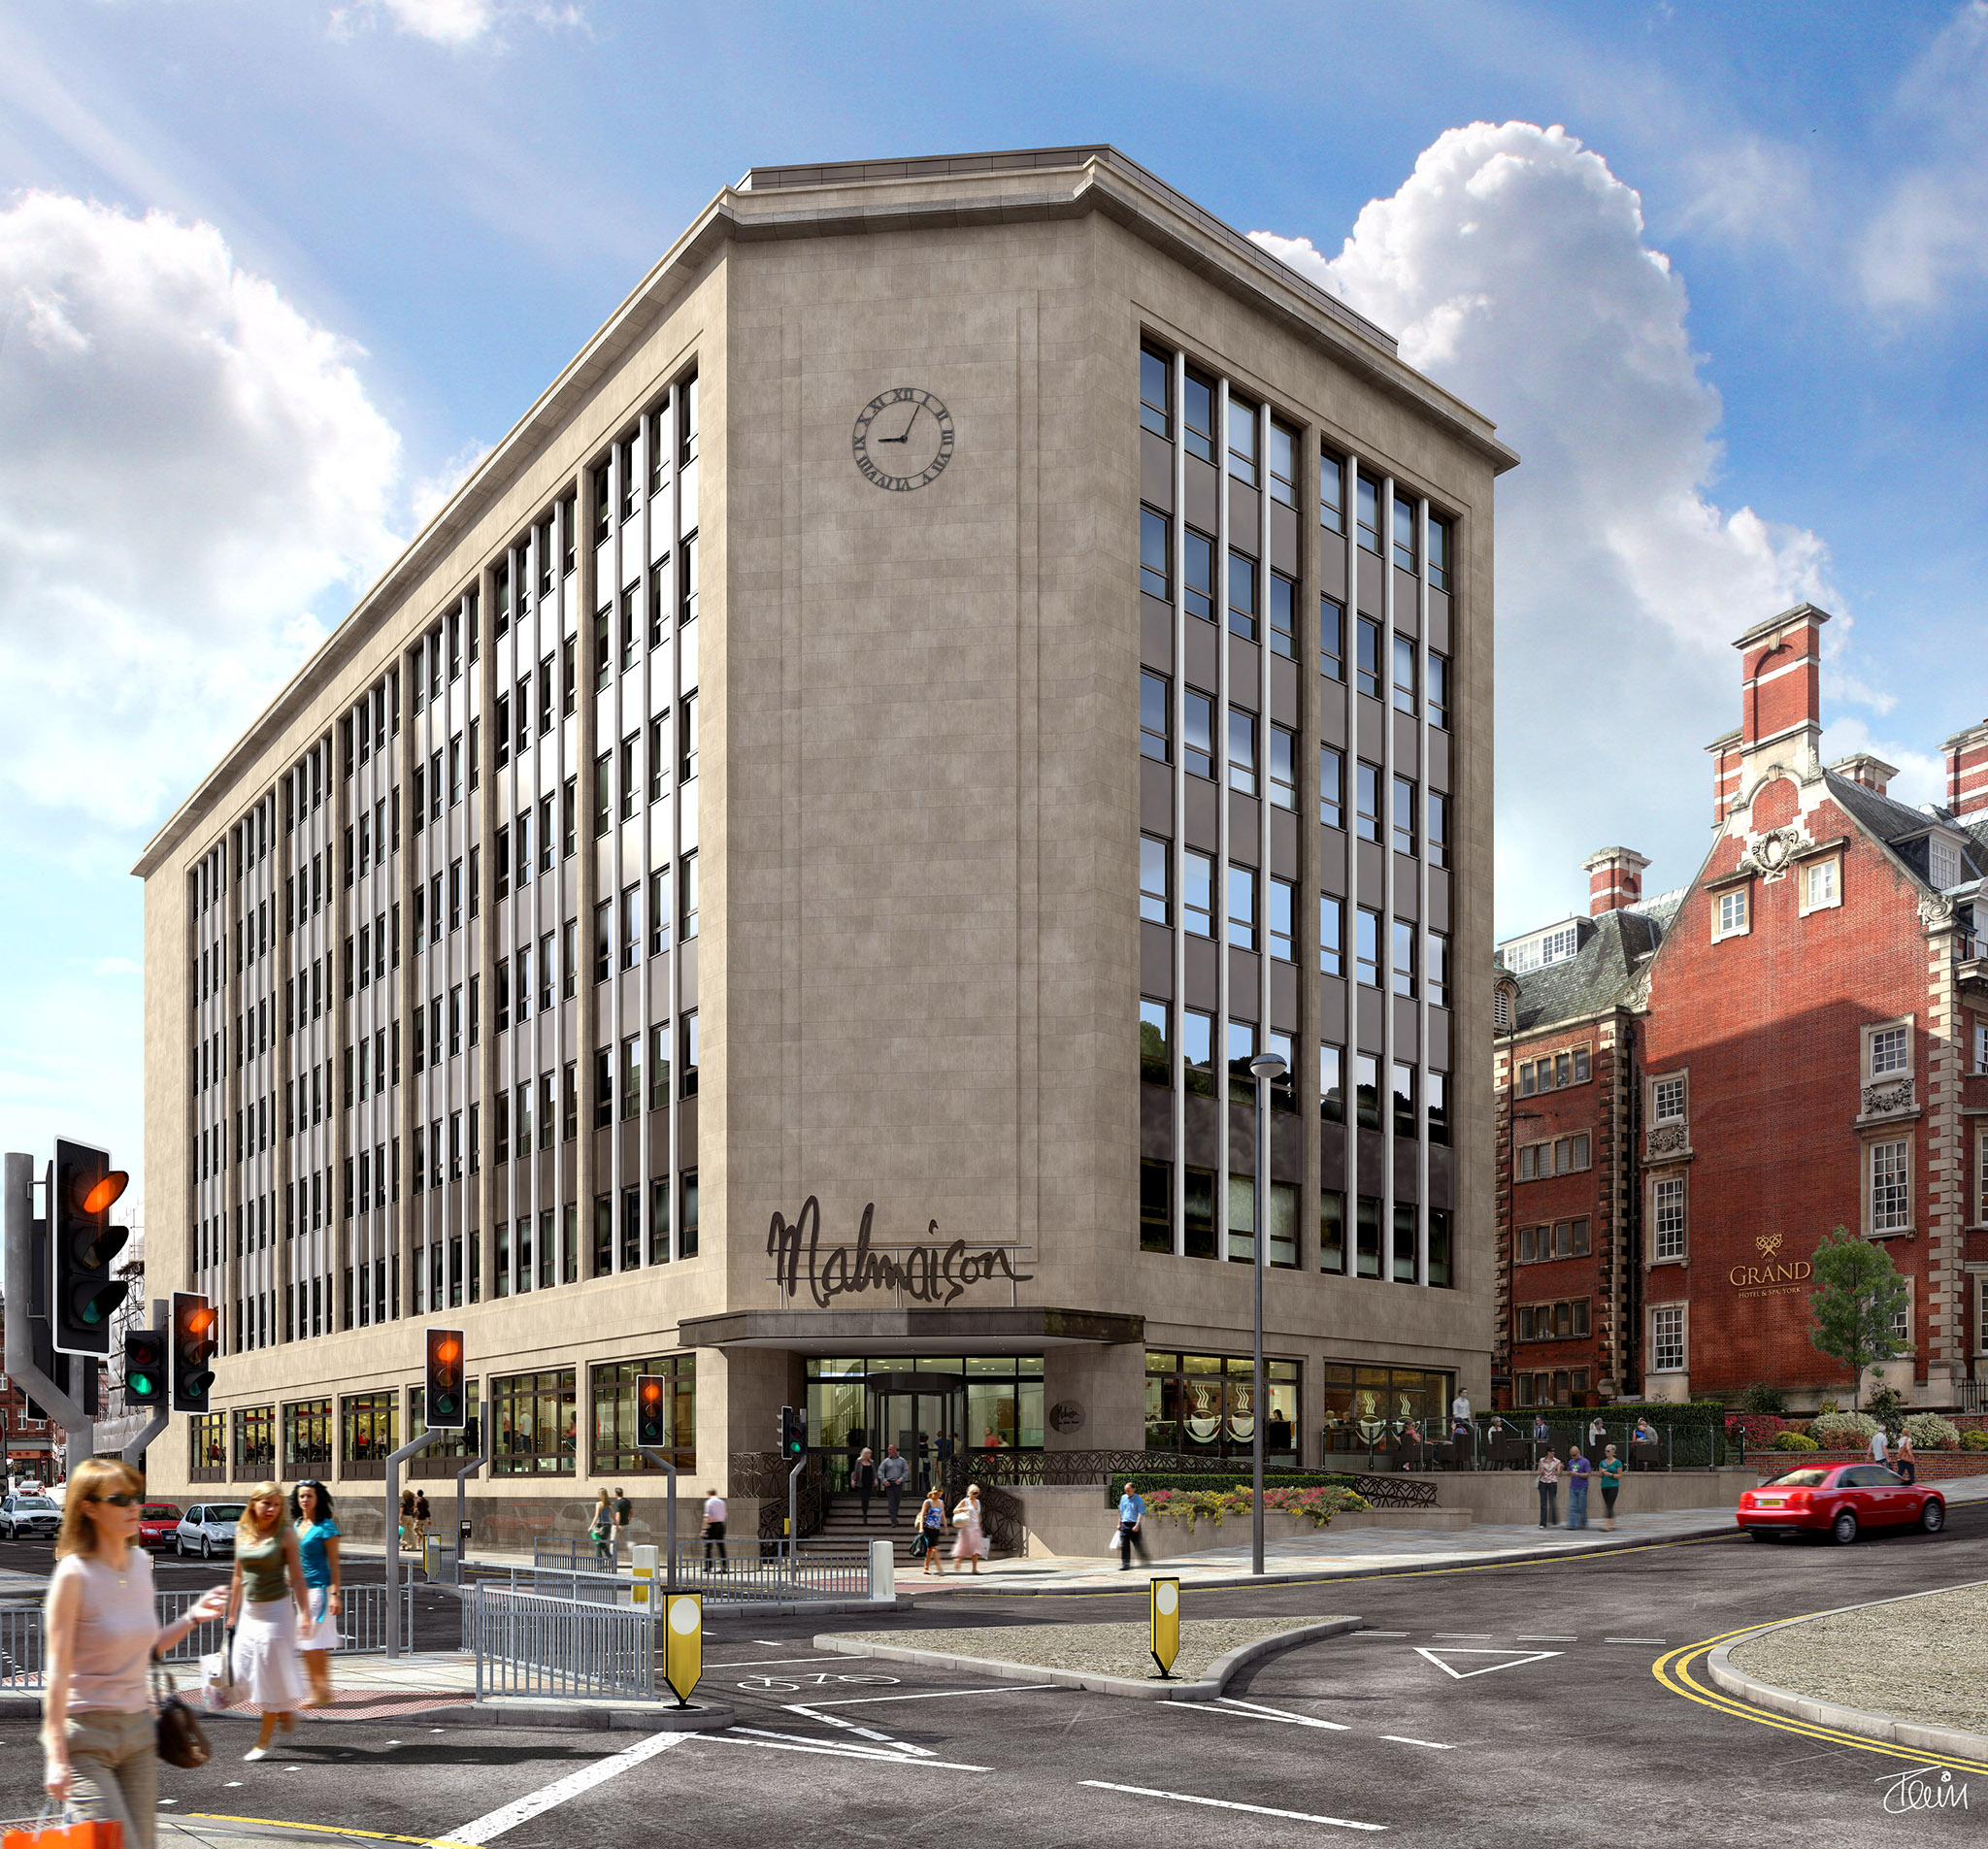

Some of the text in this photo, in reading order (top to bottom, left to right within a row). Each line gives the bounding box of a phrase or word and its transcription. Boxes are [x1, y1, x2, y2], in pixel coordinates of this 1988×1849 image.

[892, 388, 914, 402] XII
[853, 435, 866, 450] IX
[942, 429, 953, 446] III
[767, 1195, 1034, 1308] Malmaison
[1730, 1261, 1811, 1286] GRAND
